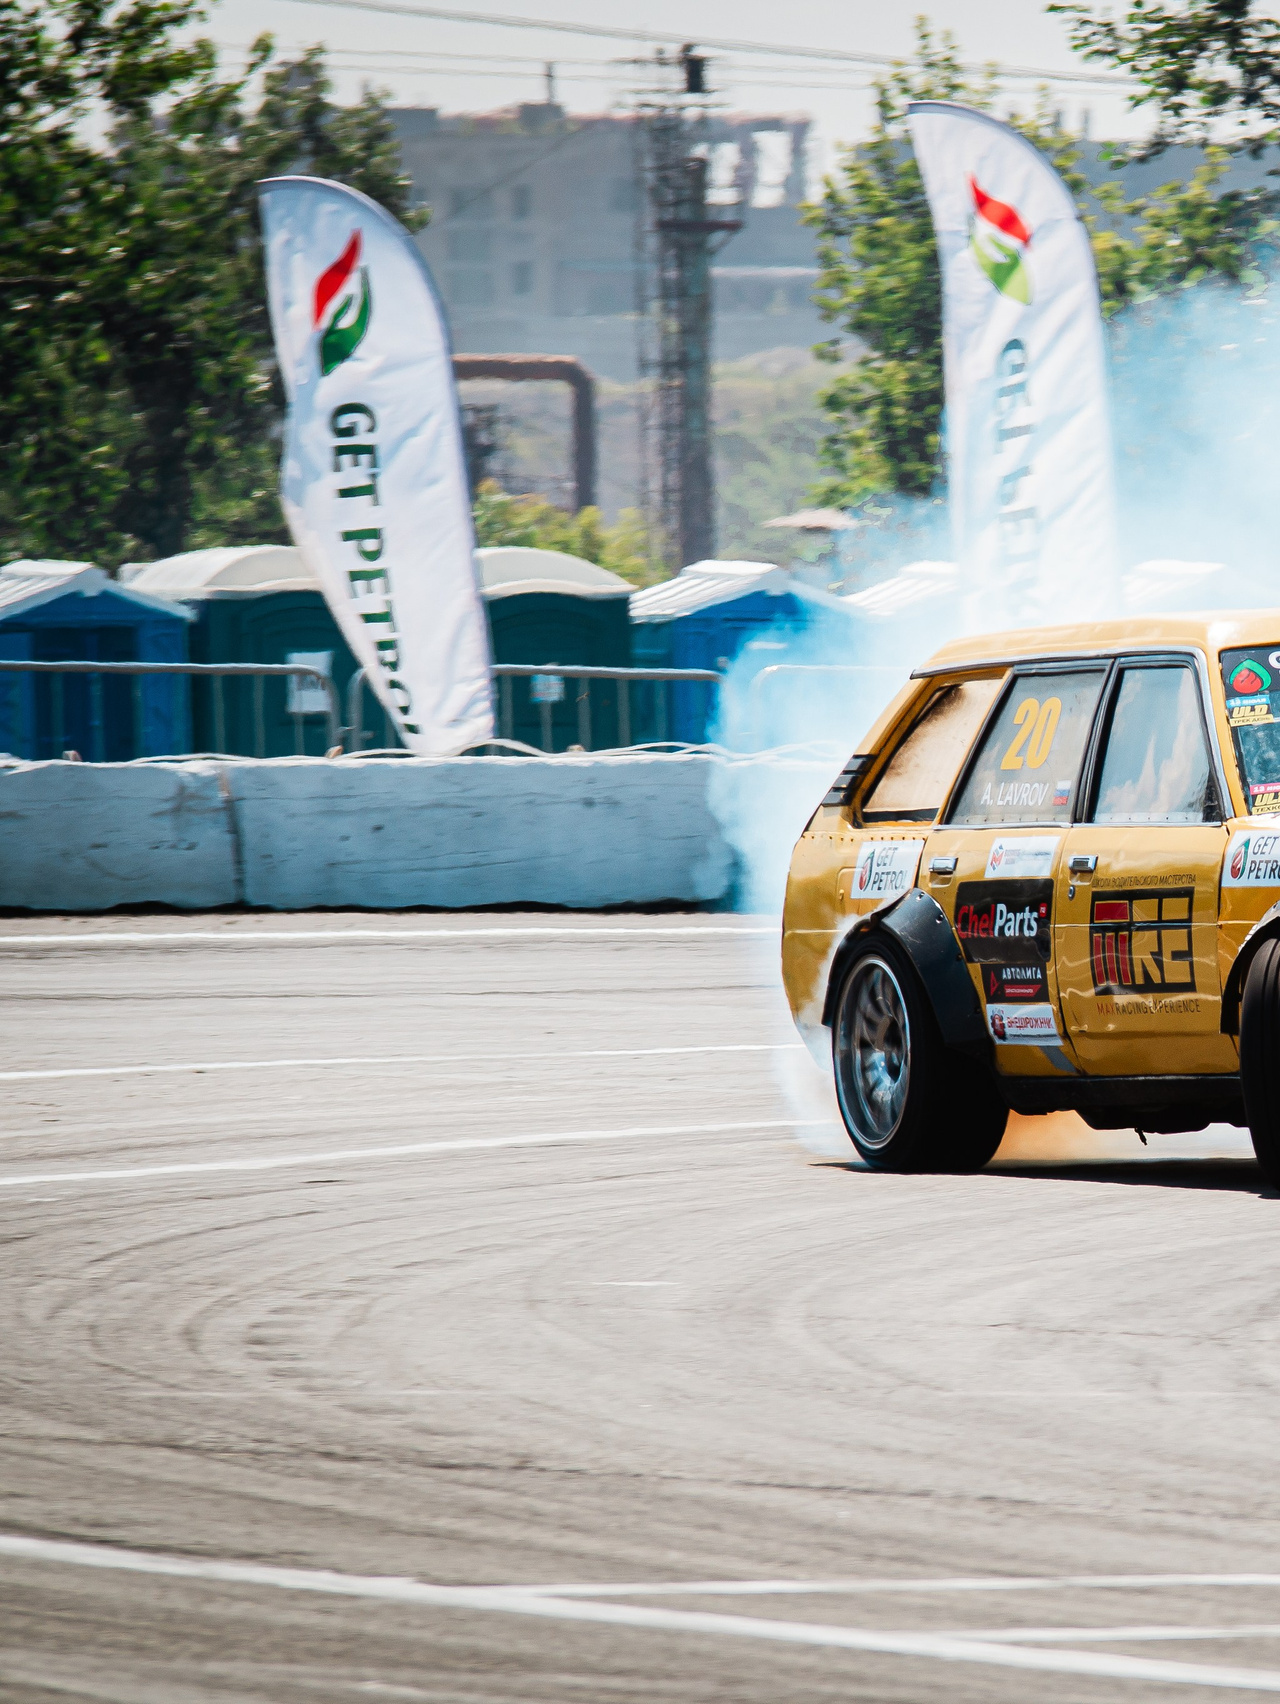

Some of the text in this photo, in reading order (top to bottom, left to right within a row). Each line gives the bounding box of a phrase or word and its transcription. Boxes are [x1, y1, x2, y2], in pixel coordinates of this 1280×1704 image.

[331, 402, 380, 507] GET
[1232, 704, 1268, 718] ULD
[1000, 696, 1062, 770] 20
[981, 782, 1049, 806] A. LAVROV
[1252, 836, 1280, 855] GET
[876, 847, 899, 867] GET
[870, 869, 907, 891] PETROL
[1159, 873, 1197, 885] МАСТЕРСТВА
[957, 903, 1039, 939] ChelParts
[1002, 967, 1042, 980] АВТОЛИГА
